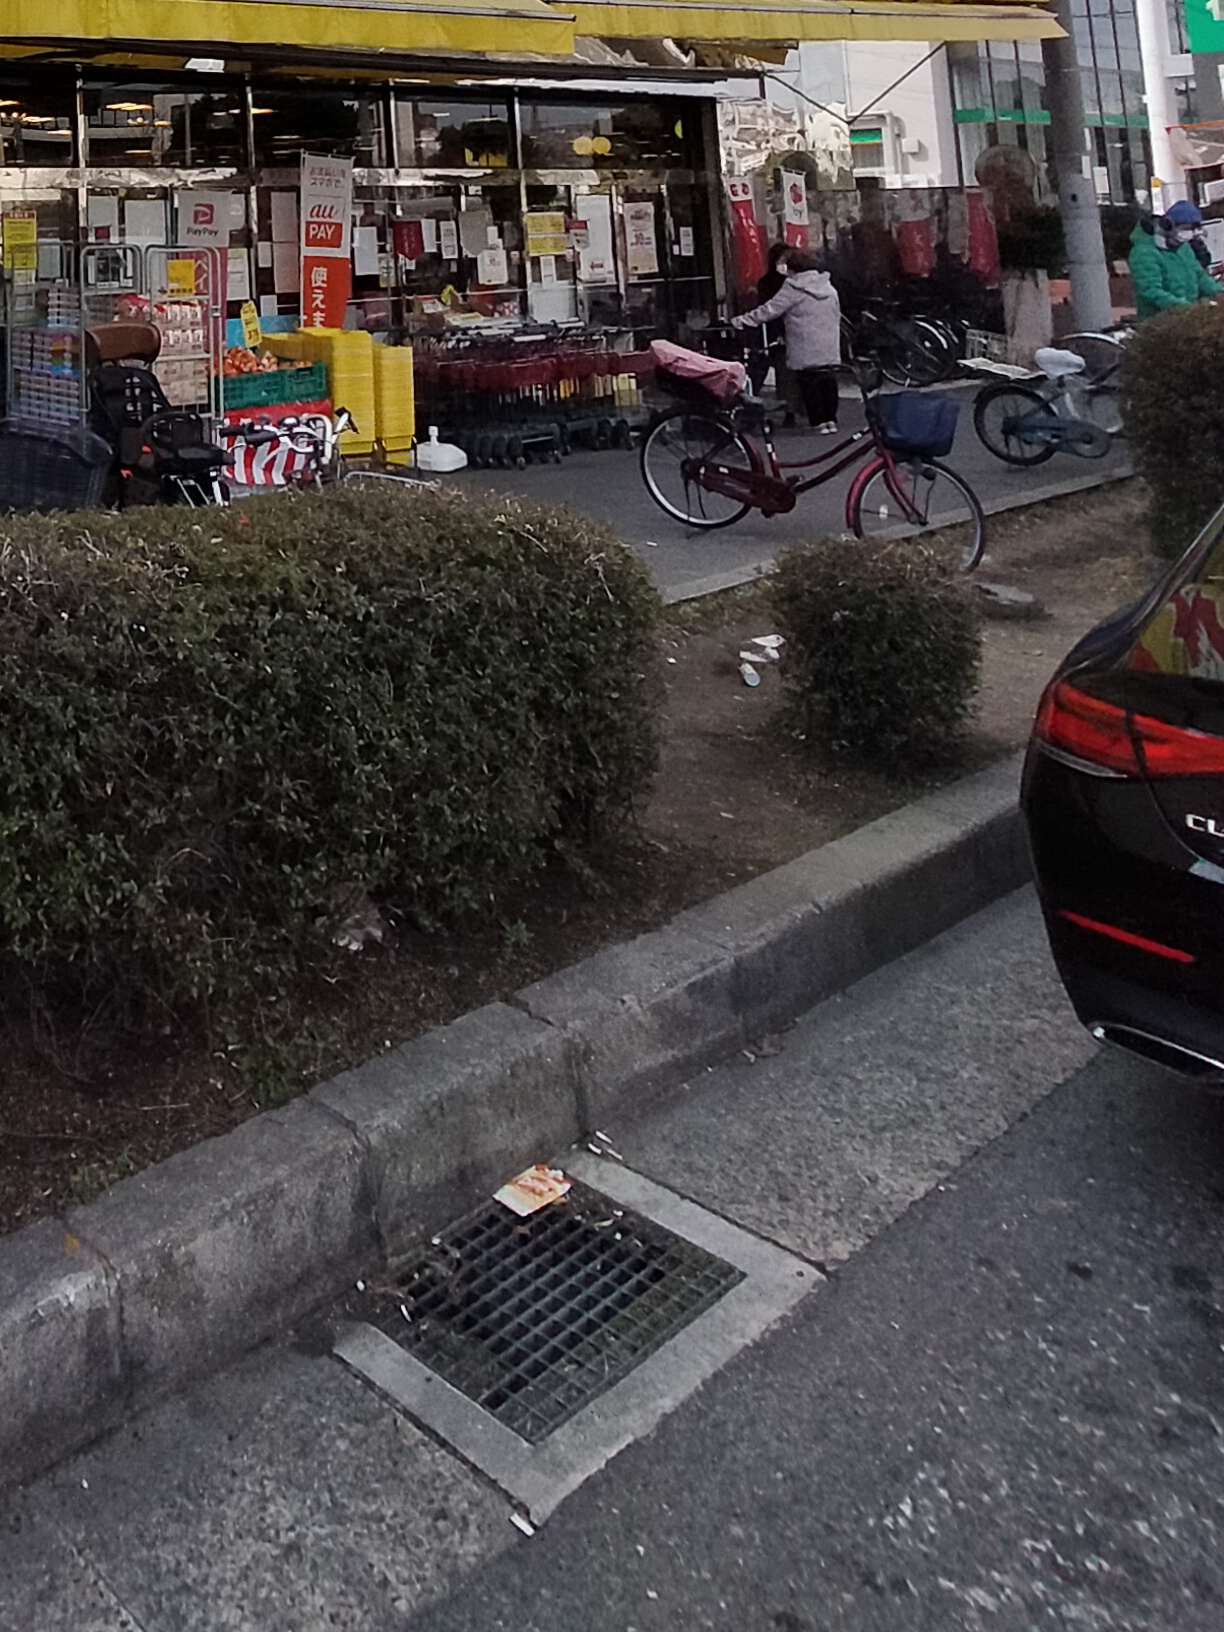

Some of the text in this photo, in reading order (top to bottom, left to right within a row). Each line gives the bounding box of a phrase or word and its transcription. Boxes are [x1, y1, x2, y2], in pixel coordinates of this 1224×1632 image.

[309, 204, 338, 219] au
[186, 226, 219, 237] PayPay
[309, 224, 336, 240] PAY
[1185, 813, 1224, 838] CL
